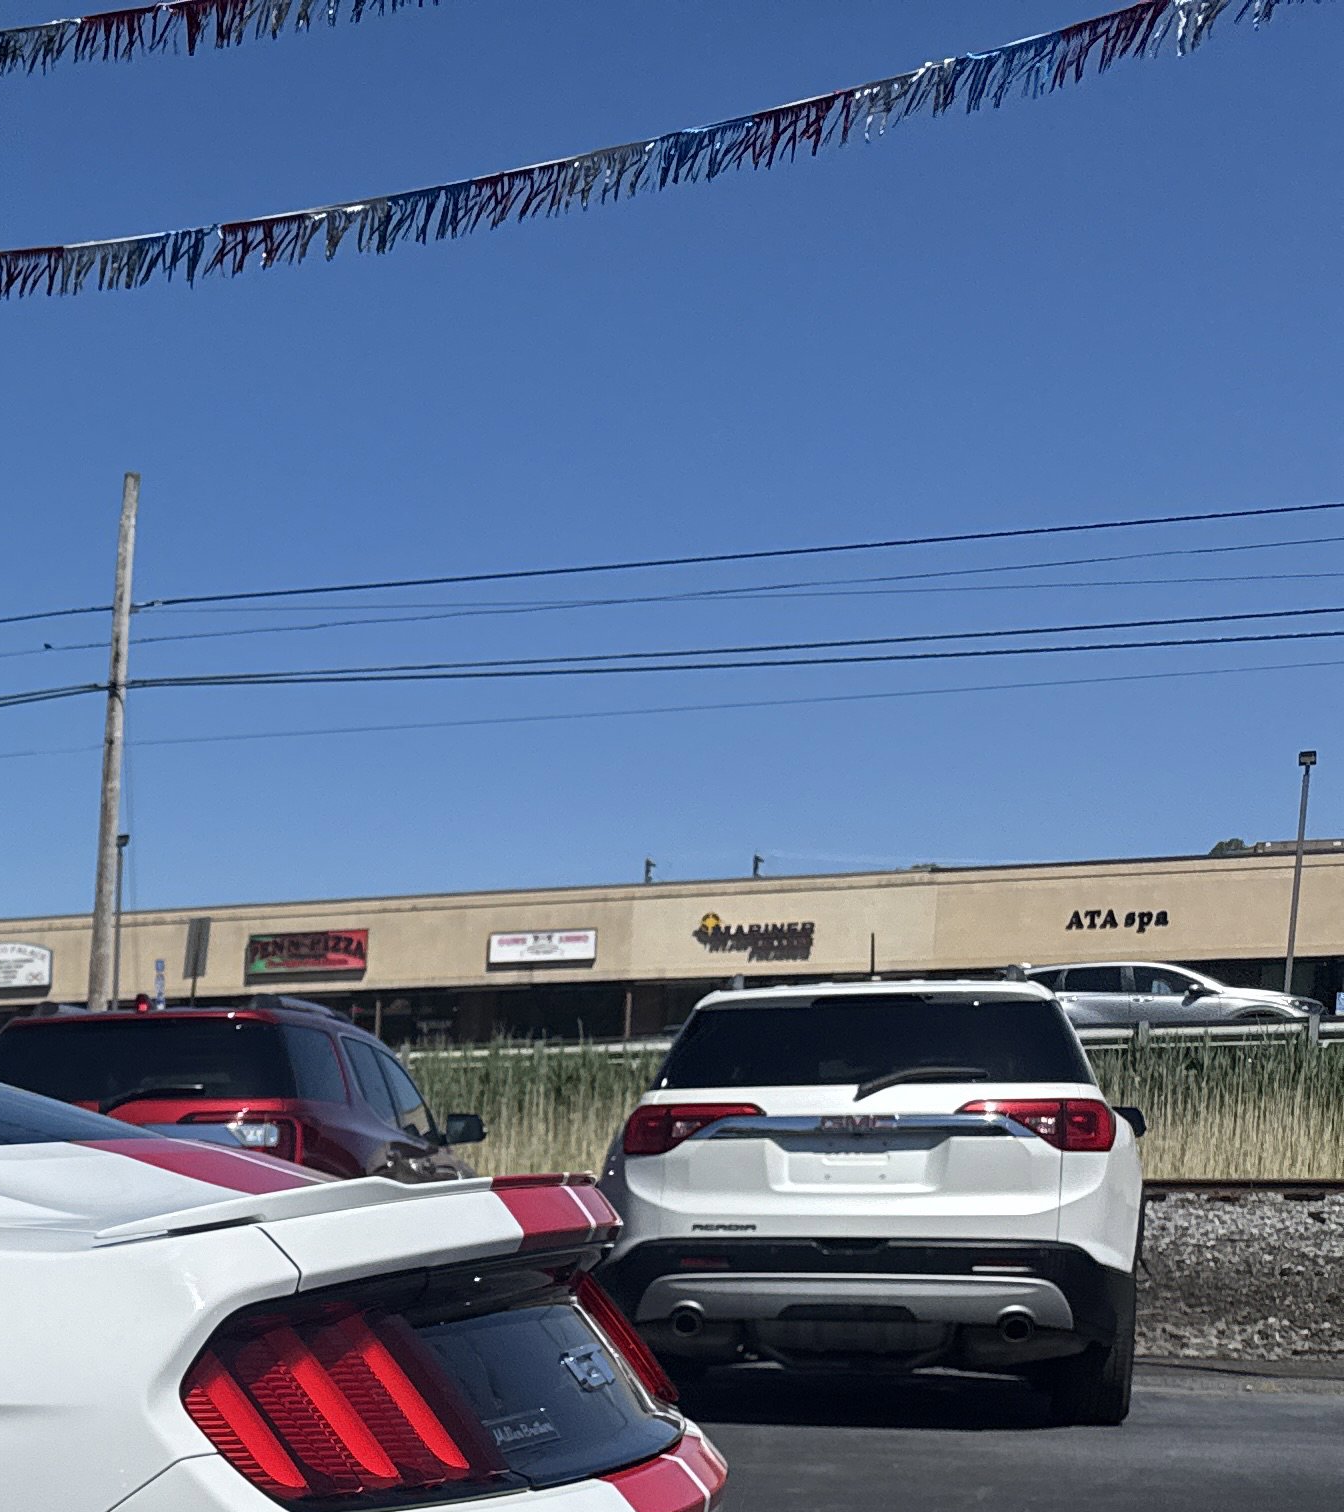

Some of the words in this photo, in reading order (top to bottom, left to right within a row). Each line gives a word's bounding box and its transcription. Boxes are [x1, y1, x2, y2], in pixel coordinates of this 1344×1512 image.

[1065, 908, 1119, 930] ATA
[1124, 910, 1169, 934] spa
[820, 1115, 897, 1132] GMC
[691, 1223, 758, 1233] ACADIA
